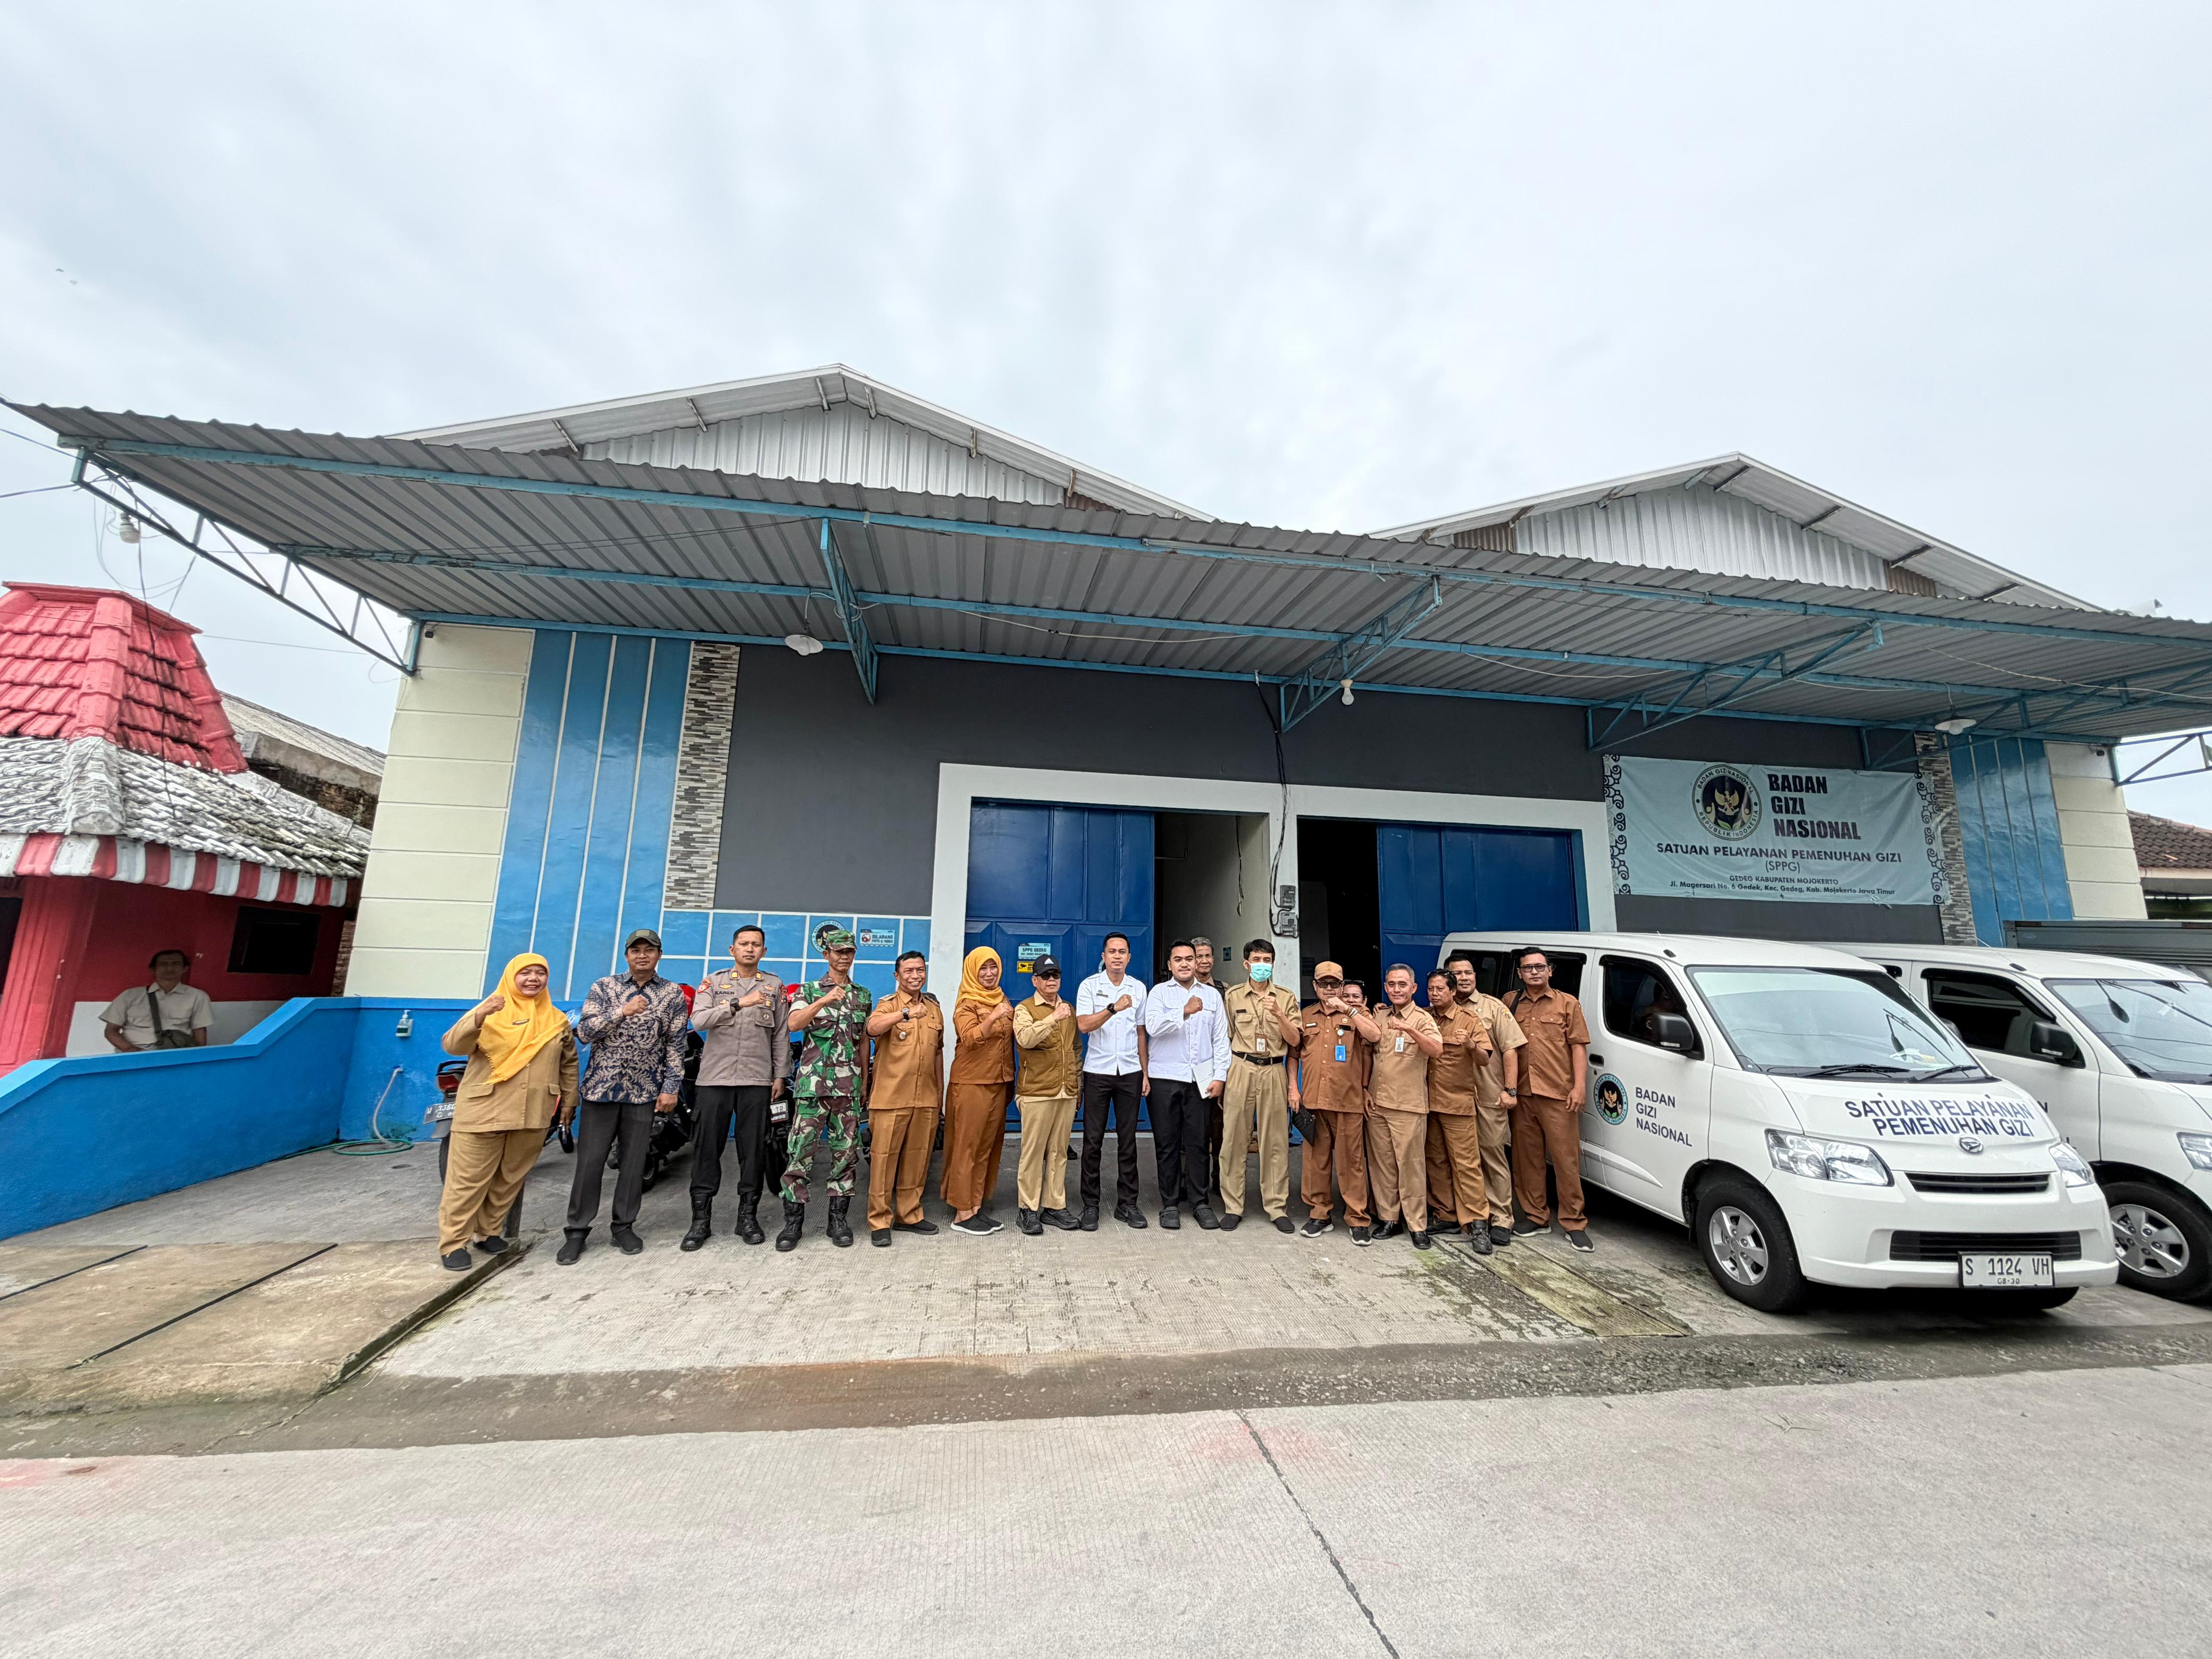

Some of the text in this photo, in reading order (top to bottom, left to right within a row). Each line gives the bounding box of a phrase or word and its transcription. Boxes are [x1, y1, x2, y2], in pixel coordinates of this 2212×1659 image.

[1697, 771, 1714, 789] BADAN
[1727, 769, 1754, 794] NASIONAL
[1767, 774, 1828, 794] BADAN
[1771, 795, 1806, 815] GIZI
[1699, 810, 1758, 837] REPUBLIK INDONESIA
[1773, 818, 1862, 840] NASIONAL
[1656, 843, 1902, 862] SATUAN PELAYANAN PEMENUHAN GIZI
[1765, 860, 1800, 874] (SPPG)
[1636, 1086, 1675, 1109] BADAN
[1636, 1102, 1657, 1119] GIZI
[1845, 1100, 1931, 1118] SATUAN
[1928, 1100, 2035, 1120] PELAYANAN
[1636, 1117, 1692, 1147] NASIONAL
[1872, 1117, 2034, 1137] PEMENUHAN GIZI
[1965, 1258, 2049, 1276] S 1124 VH
